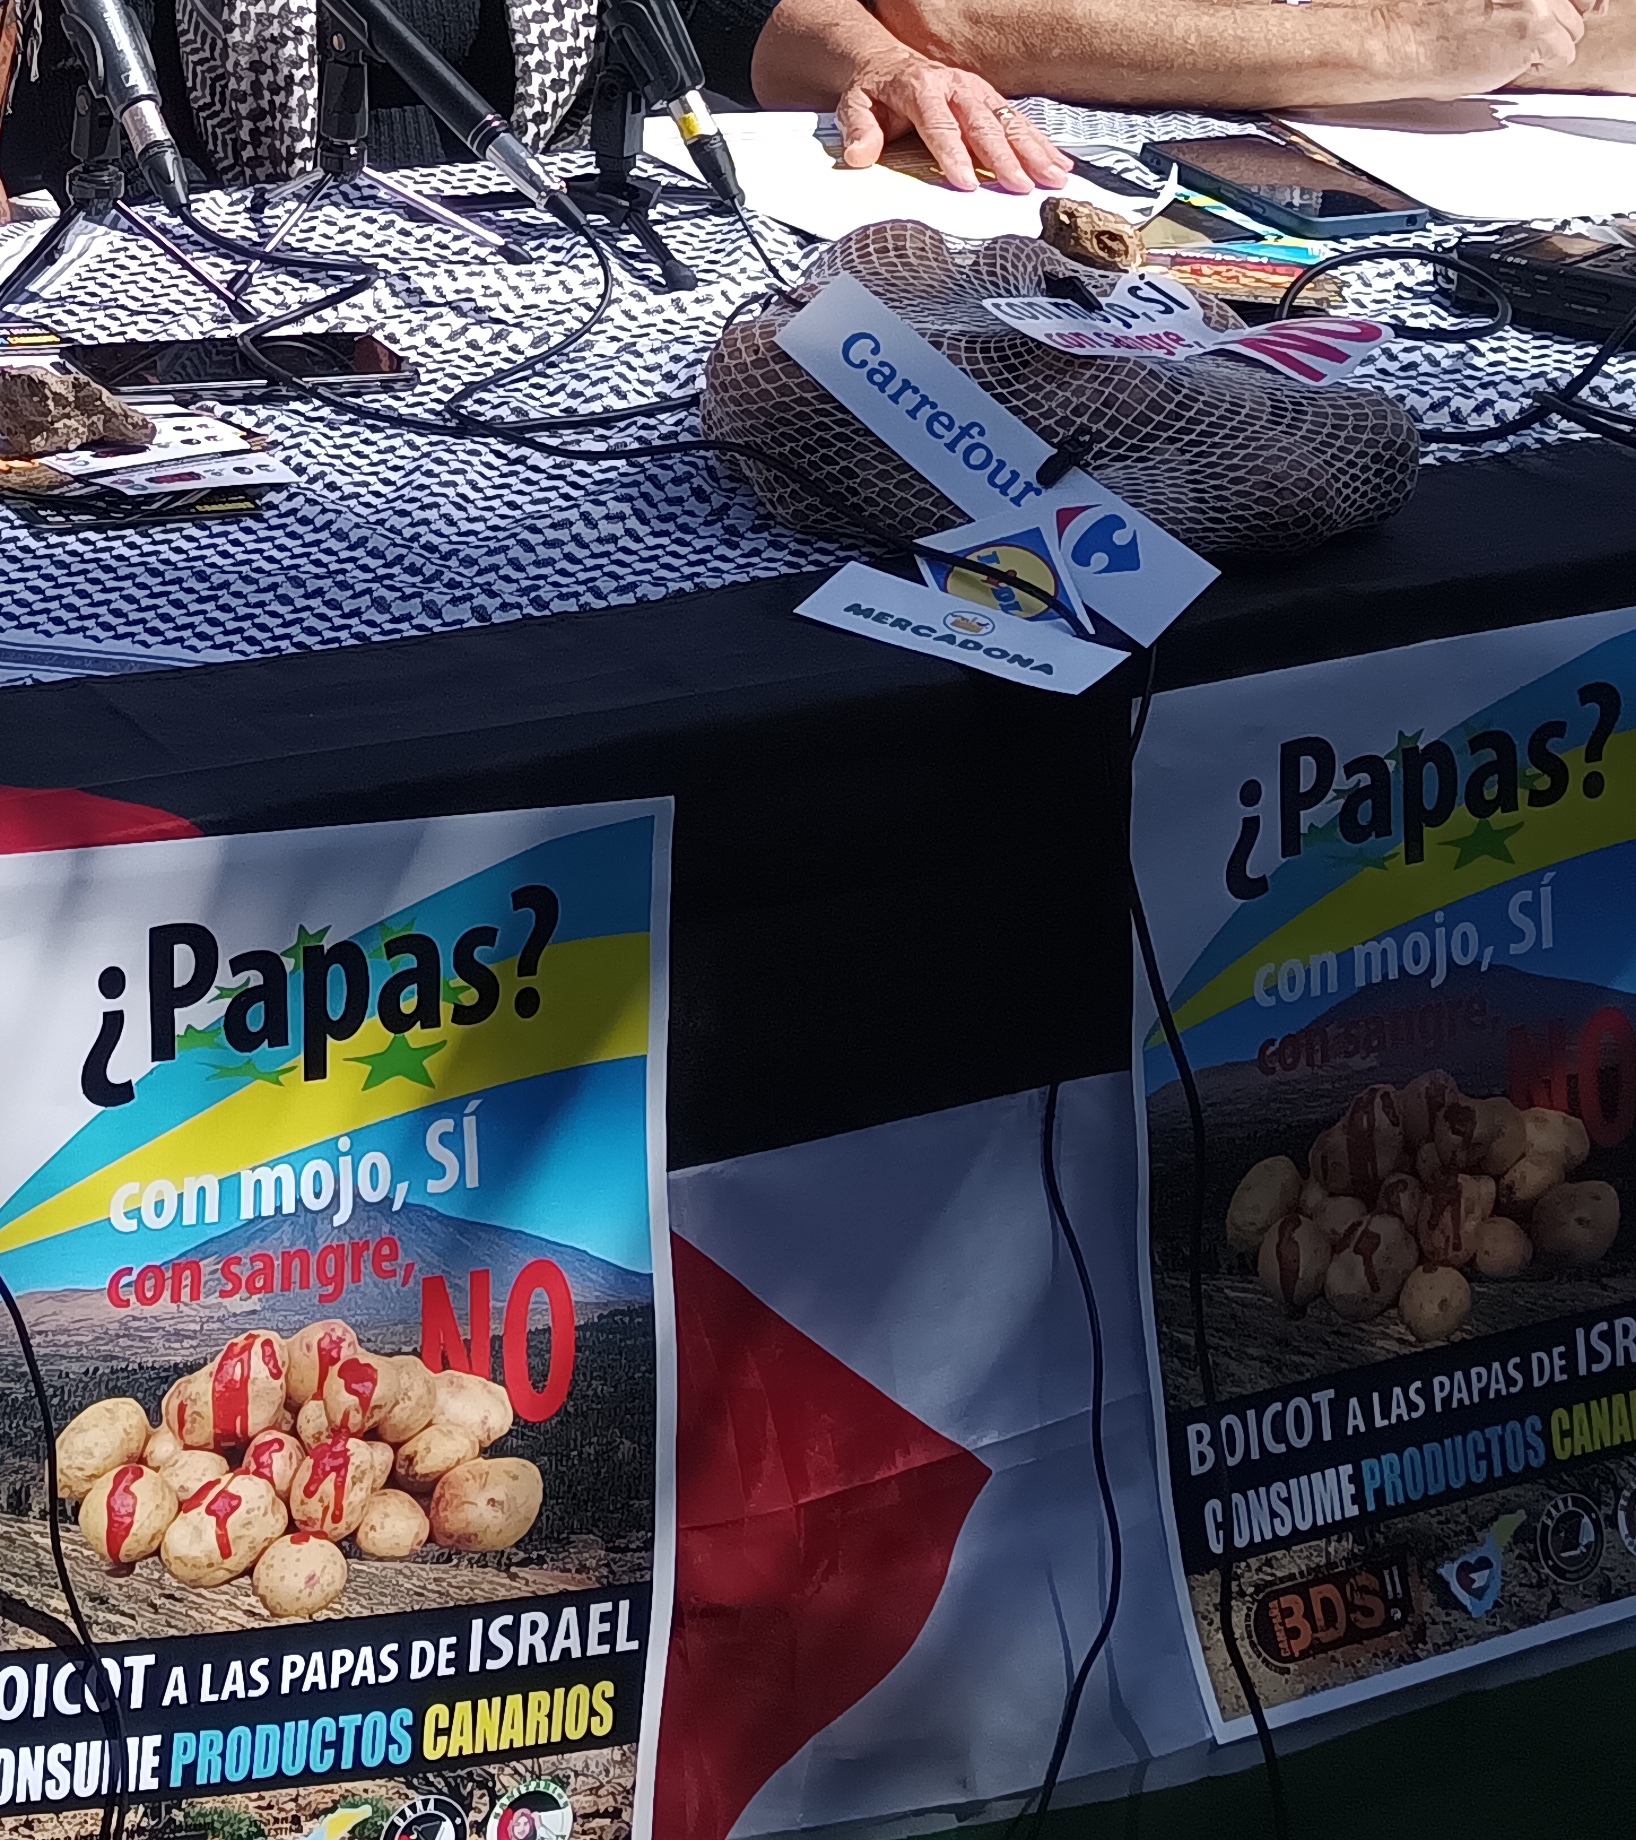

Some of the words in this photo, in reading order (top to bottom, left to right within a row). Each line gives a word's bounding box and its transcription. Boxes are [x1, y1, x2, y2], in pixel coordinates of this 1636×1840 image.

[991, 300, 1052, 322] con
[1128, 273, 1189, 315] SÍ
[1044, 331, 1094, 349] con
[1096, 330, 1205, 357] sangre,
[842, 332, 1042, 507] Carrefour
[843, 603, 1054, 675] MERCADONA
[1225, 681, 1622, 900] ¿Papas?
[81, 885, 560, 1107] ¿Papas?
[1253, 949, 1337, 1008] con
[1353, 909, 1494, 989] mojo,
[1507, 871, 1557, 955] SÍ
[1257, 1025, 1330, 1076] con
[109, 1172, 219, 1232] con
[239, 1136, 409, 1227] mojo,
[426, 1098, 482, 1194] SÍ
[107, 1260, 201, 1308] con
[219, 1236, 415, 1304] sangre,
[420, 1259, 575, 1423] NO
[1186, 1388, 1335, 1477] BOICOT
[1346, 1396, 1366, 1436] A
[1373, 1380, 1426, 1428] LAS
[1433, 1356, 1524, 1413] PAPAS
[1531, 1345, 1568, 1390] DE
[1203, 1463, 1360, 1555] CONSUME
[1362, 1414, 1546, 1512] PRODUCTOS
[162, 1675, 188, 1707] A
[200, 1661, 270, 1704] LAS
[279, 1648, 400, 1696] PAPAS
[409, 1642, 456, 1680] DE
[468, 1598, 640, 1674] ISRAEL
[169, 1707, 416, 1788] PRODUCTOS
[422, 1680, 615, 1762] CANARIOS
